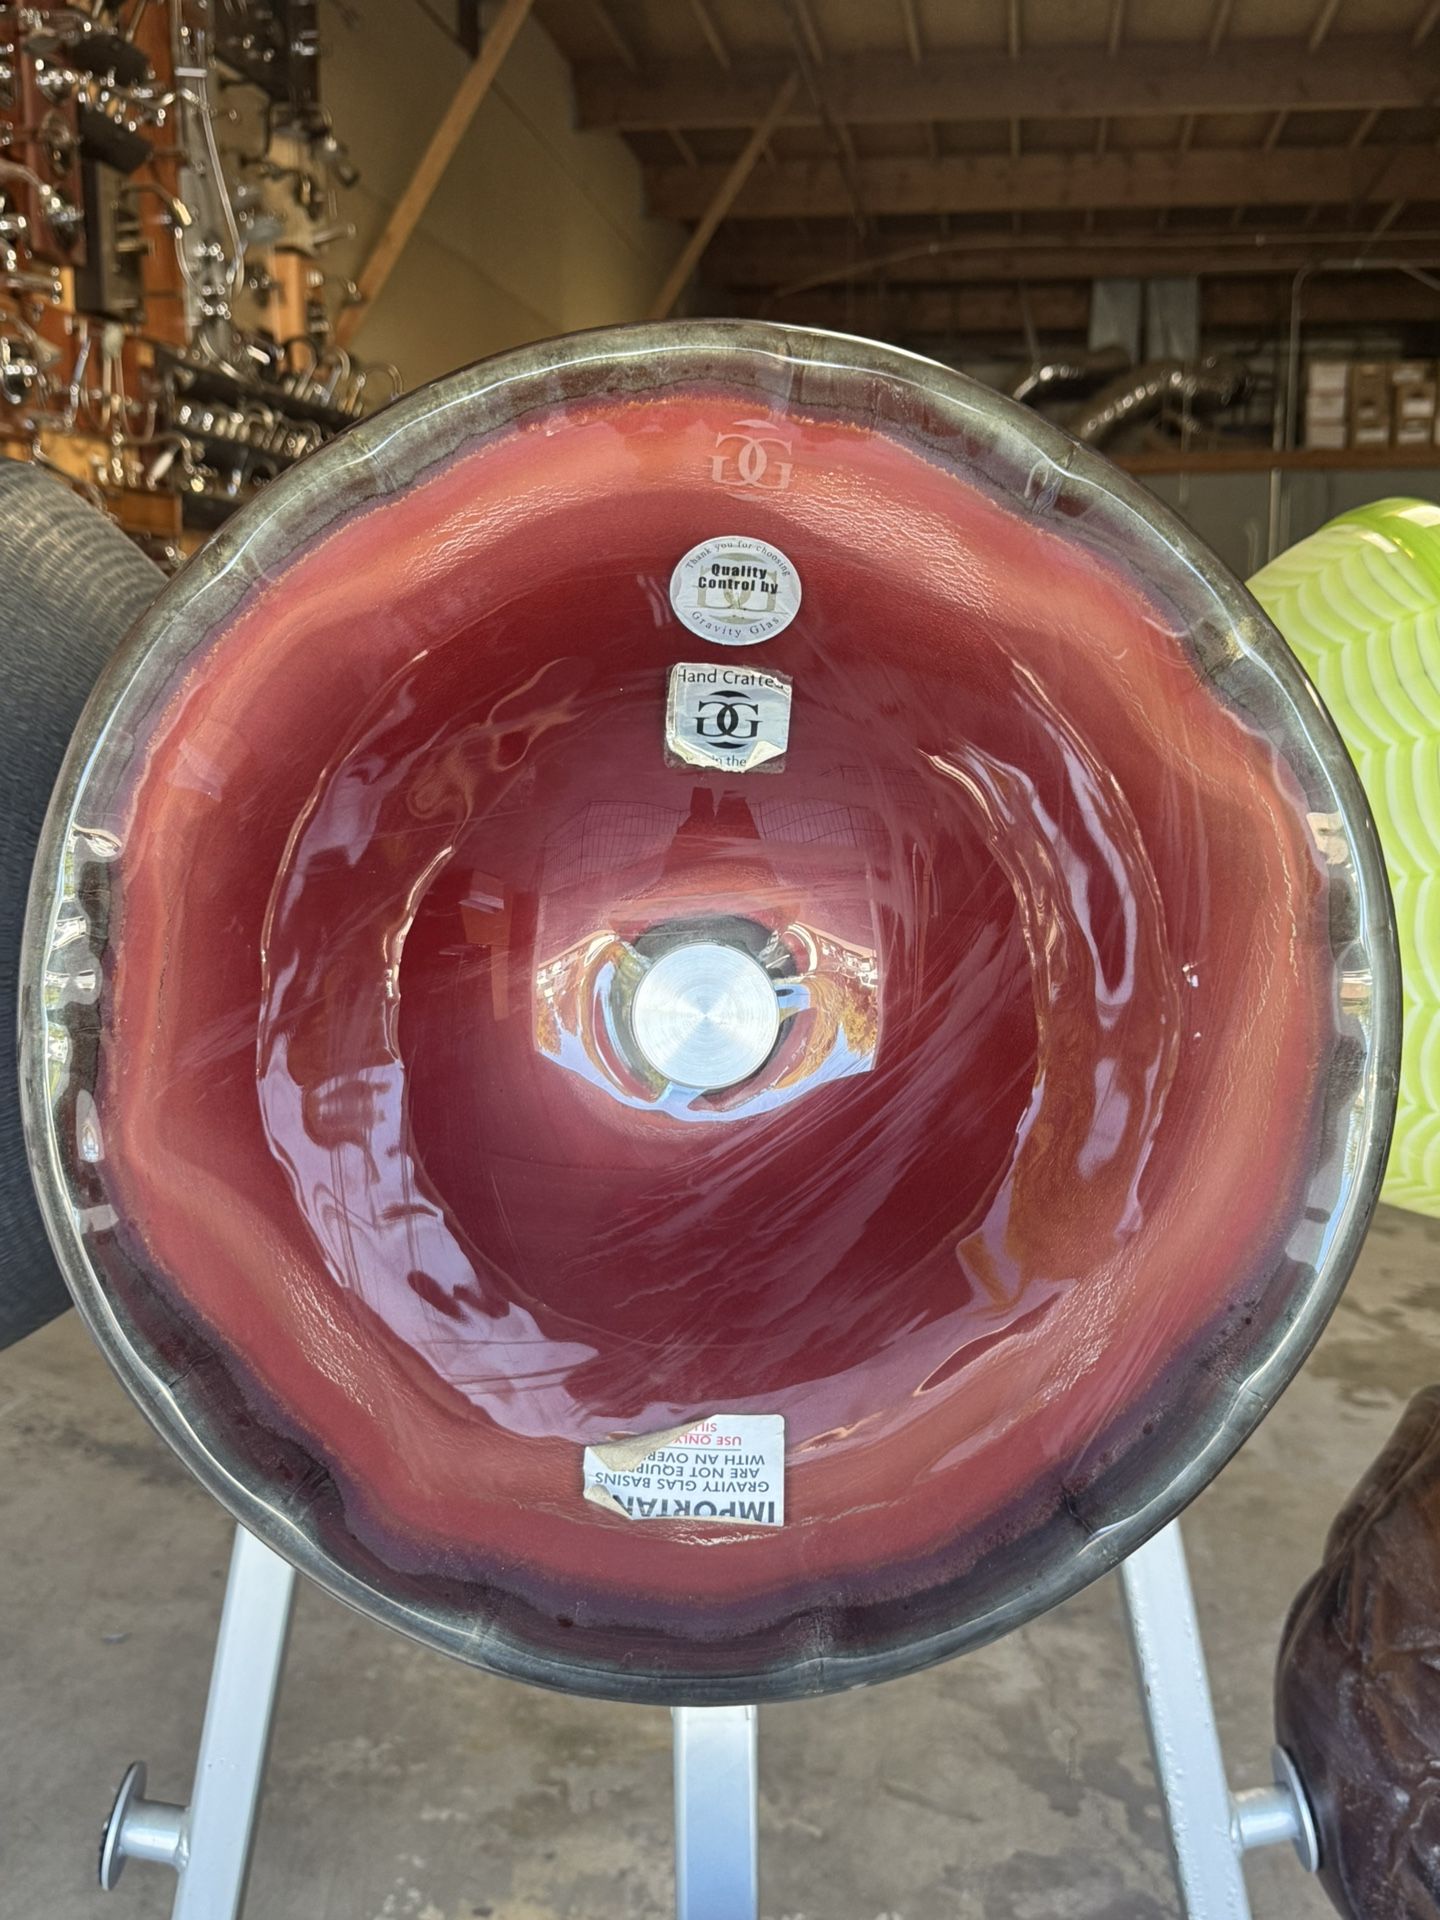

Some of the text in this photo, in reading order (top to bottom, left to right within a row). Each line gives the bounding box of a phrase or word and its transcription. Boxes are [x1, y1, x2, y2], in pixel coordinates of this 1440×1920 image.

[685, 540, 791, 577] Thank you for choosing
[711, 563, 767, 579] Quality
[698, 576, 778, 594] Control by
[691, 611, 780, 638] Gravity Glas
[723, 670, 784, 690] Crafte
[726, 755, 747, 767] the
[716, 1436, 742, 1446] USE
[643, 1452, 765, 1465] WITH AN OVER
[629, 1463, 760, 1479] ARE NOT EQUIP
[595, 1472, 770, 1493] GRAVITY GLAS BASINS
[612, 1494, 775, 1523] IMPORTAN
